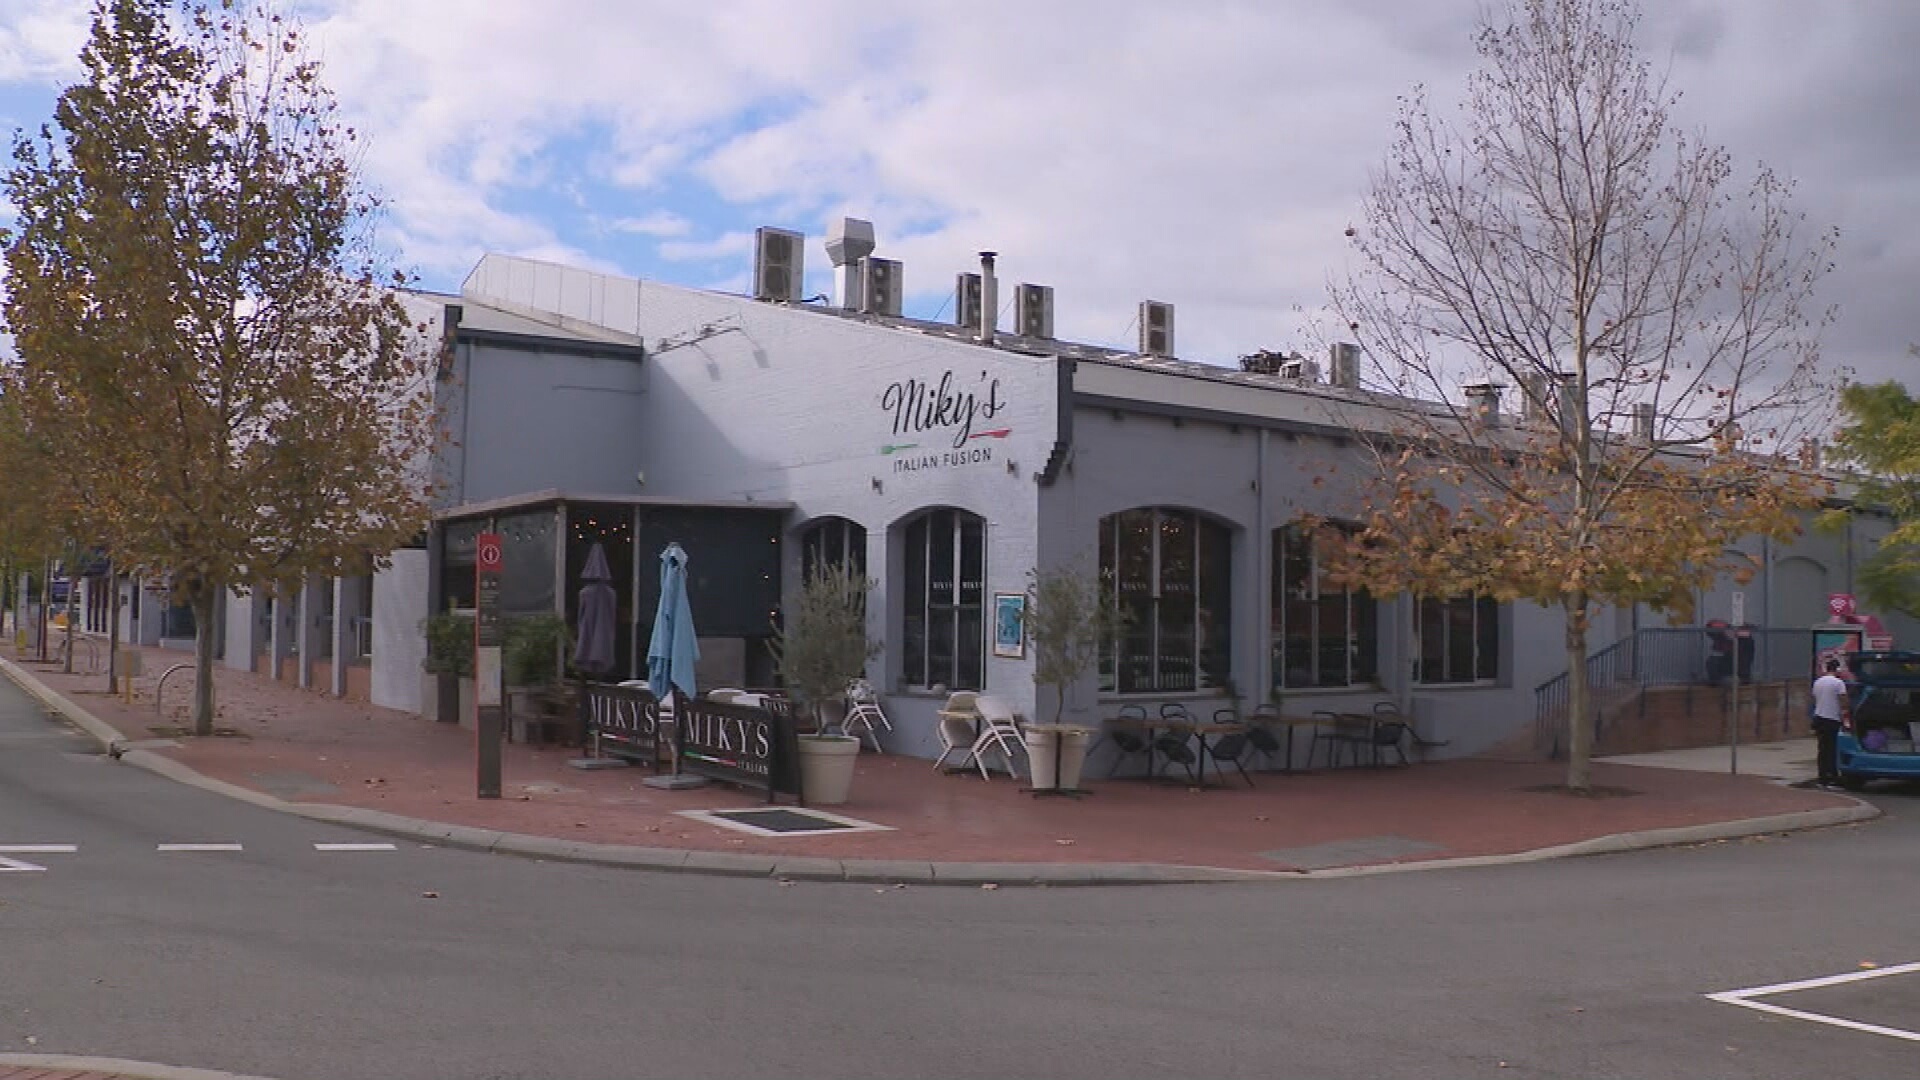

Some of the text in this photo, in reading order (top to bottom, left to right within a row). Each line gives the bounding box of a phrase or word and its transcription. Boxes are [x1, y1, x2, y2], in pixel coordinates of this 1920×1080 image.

[882, 369, 1006, 448] Miky's
[893, 448, 992, 473] ITALIAN FUSION
[589, 693, 656, 735] MIKYS
[684, 710, 769, 759] MIKYS
